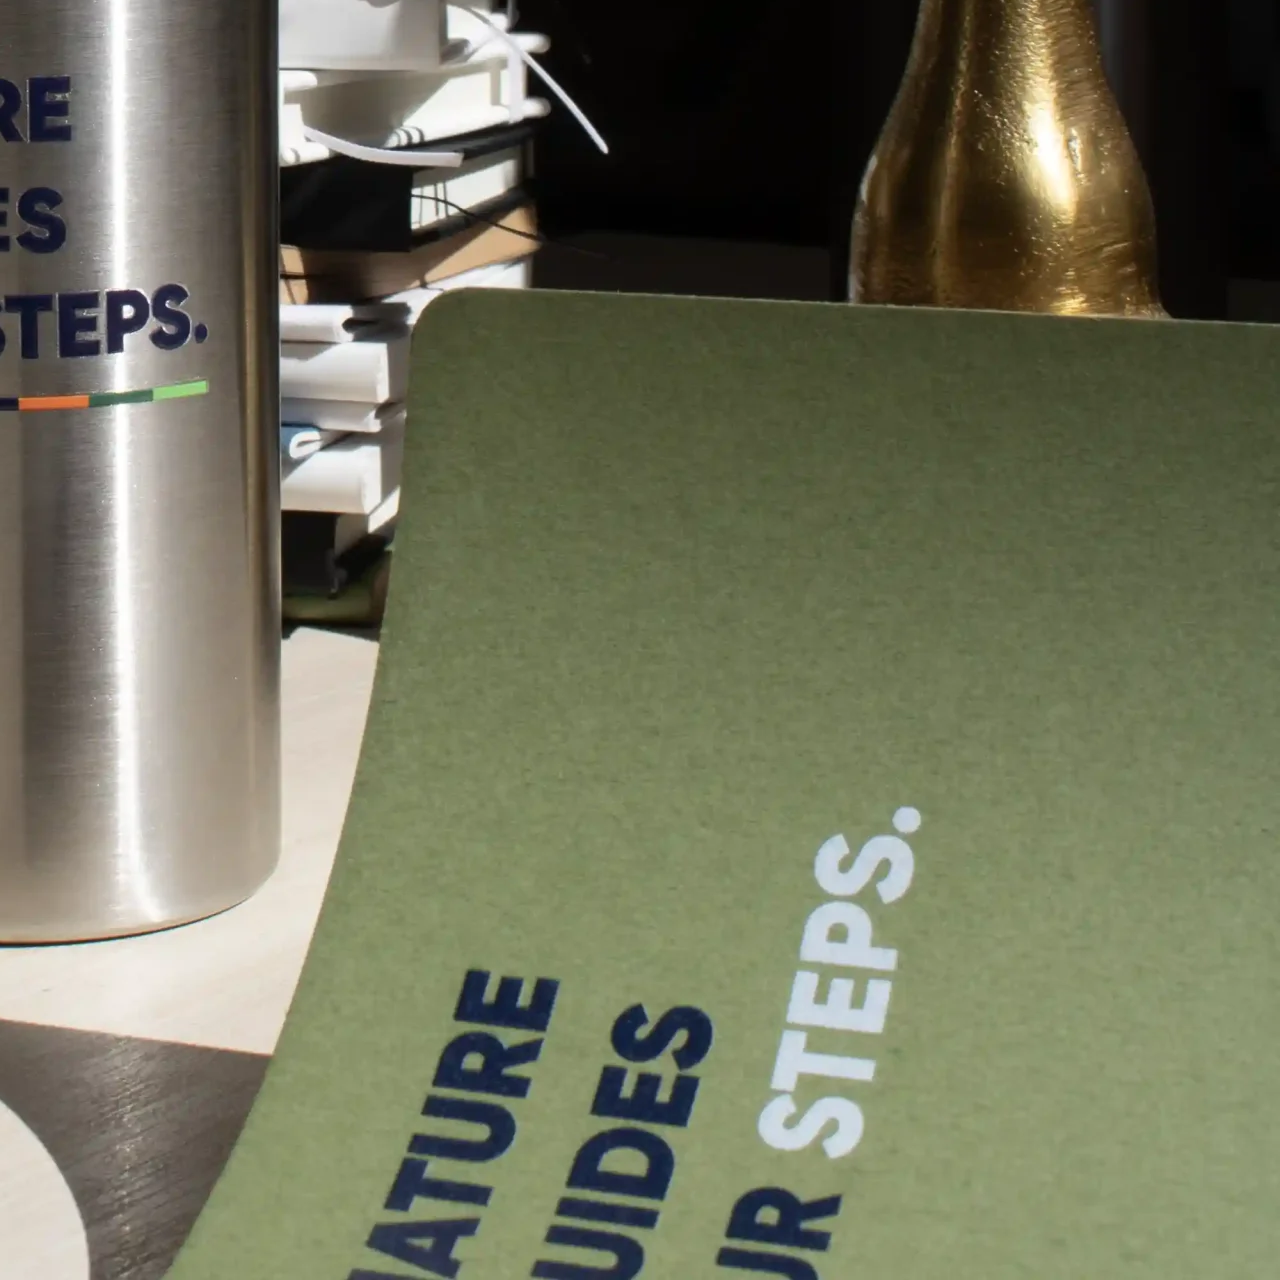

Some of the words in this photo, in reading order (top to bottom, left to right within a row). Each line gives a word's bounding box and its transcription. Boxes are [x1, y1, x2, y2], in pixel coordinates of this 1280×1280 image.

[346, 968, 560, 1280] ATURE
[757, 806, 921, 1159] STEPS.
[531, 1003, 713, 1280] UIDES
